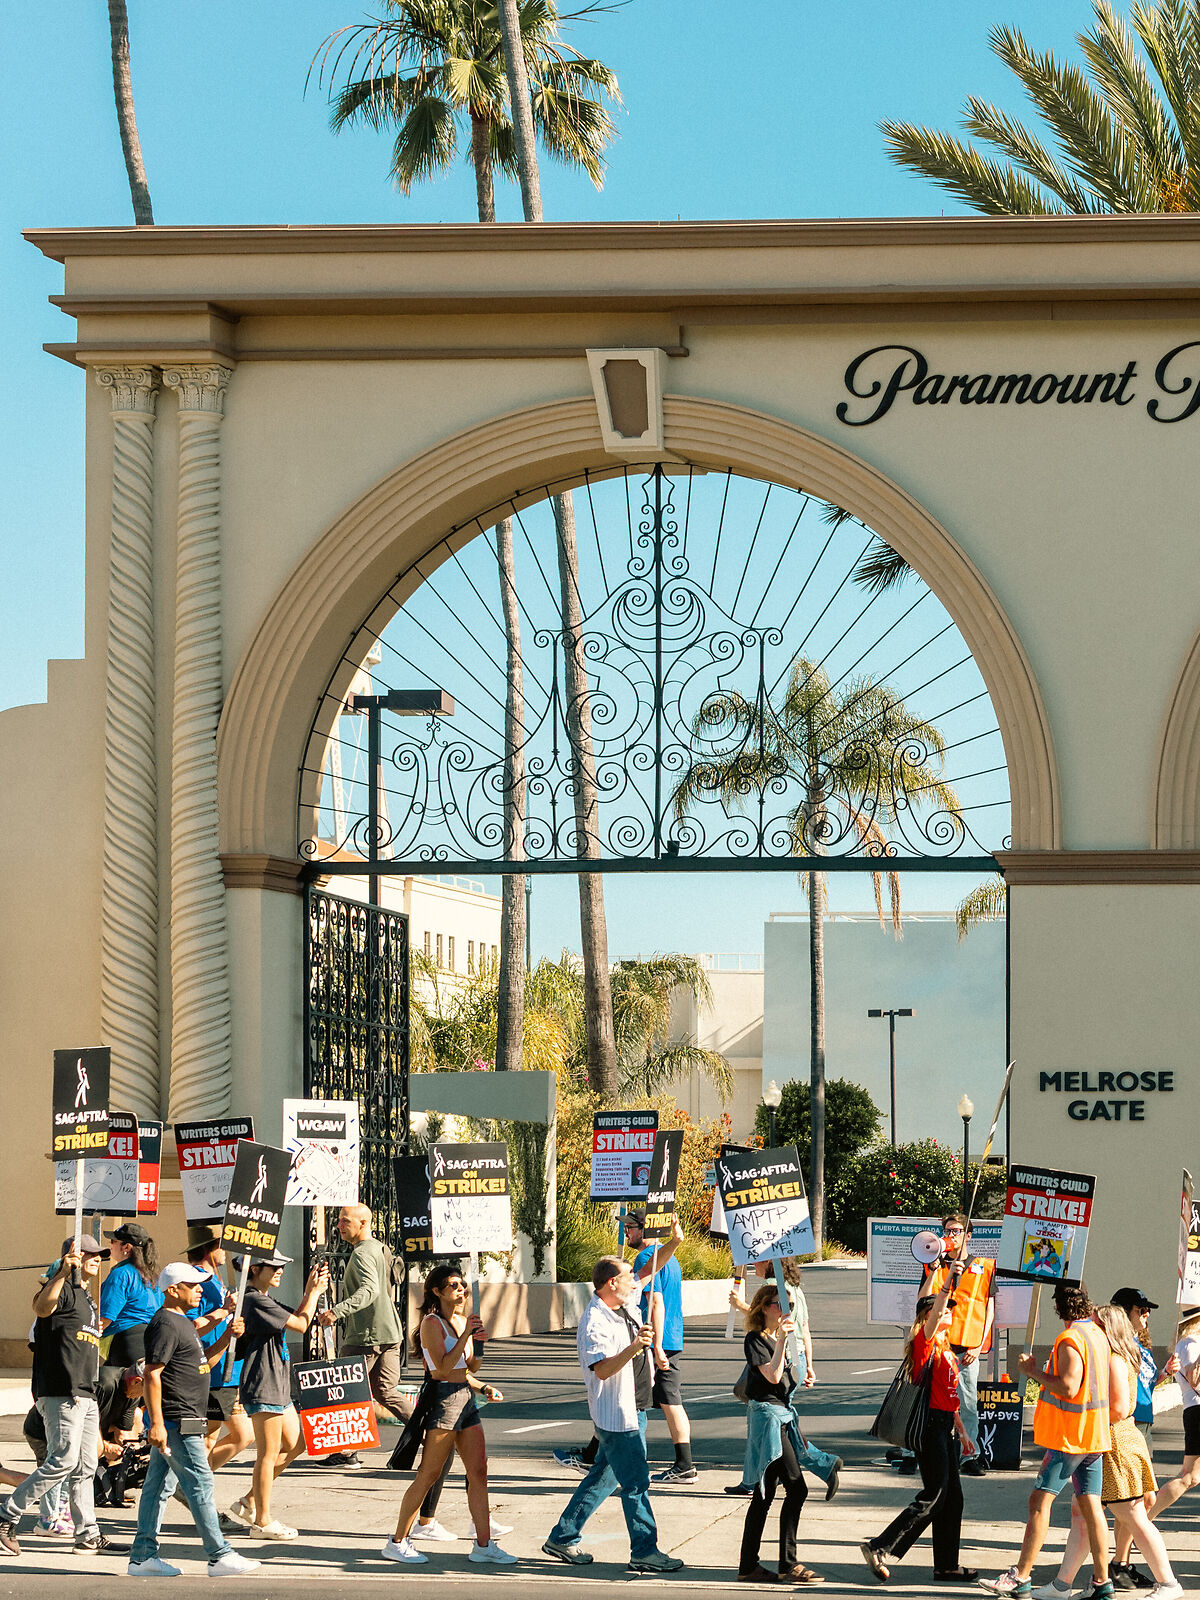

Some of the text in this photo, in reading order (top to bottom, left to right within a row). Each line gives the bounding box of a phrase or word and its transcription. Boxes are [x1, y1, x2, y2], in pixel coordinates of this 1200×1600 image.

[836, 344, 1137, 426] Paramount
[1039, 1071, 1174, 1092] MELROSE
[1067, 1100, 1145, 1121] GATE
[75, 1125, 88, 1134] ON
[297, 1119, 345, 1131] WGAW
[597, 1116, 655, 1126] WRITERS GUILD
[54, 1131, 108, 1151] STRIKE!
[138, 1128, 158, 1137] UILD
[180, 1124, 249, 1140] WRITERS GUILD
[596, 1132, 655, 1150] STRIKE!
[182, 1144, 239, 1167] STRIK
[462, 1170, 478, 1179] ON
[752, 1177, 769, 1188] ON
[1015, 1171, 1090, 1193] WRITERS GUILD
[434, 1178, 506, 1195] STRIKE!
[725, 1181, 801, 1208] STRIKE!
[1045, 1188, 1056, 1197] ON
[1010, 1192, 1087, 1224] STRIKE!
[246, 1220, 259, 1231] ON
[732, 1205, 788, 1231] AMPTP
[1047, 1221, 1068, 1229] AMPTP
[222, 1224, 277, 1251] STRIKE!
[298, 1363, 364, 1390] STRIKE
[327, 1386, 345, 1401] ON
[305, 1406, 370, 1427] AMERICA
[312, 1419, 369, 1435] GUILD OF
[312, 1430, 375, 1450] WRITERS
